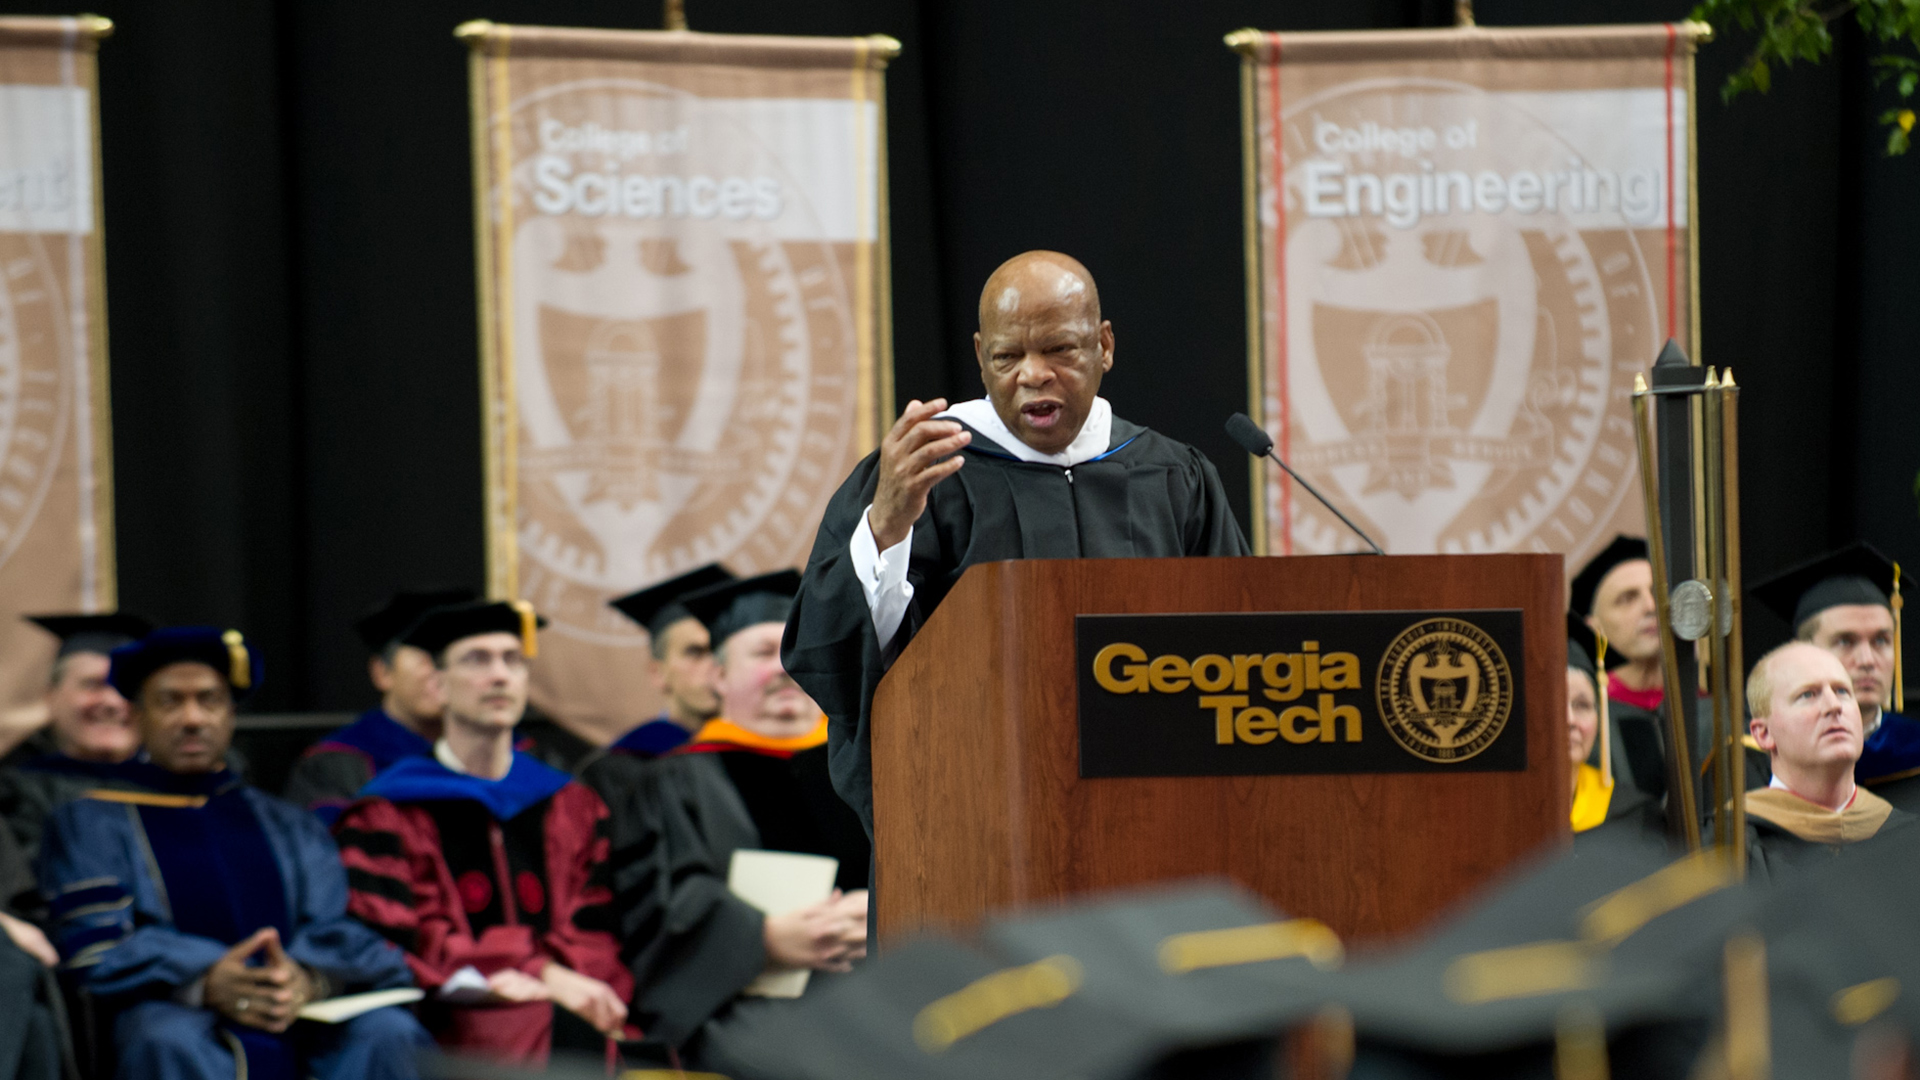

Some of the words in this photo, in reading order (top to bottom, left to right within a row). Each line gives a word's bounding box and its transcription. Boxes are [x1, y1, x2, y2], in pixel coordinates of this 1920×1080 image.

[540, 118, 652, 158] College
[654, 122, 691, 154] of
[1315, 120, 1437, 157] College
[1445, 117, 1478, 149] of
[532, 155, 782, 220] Sciences
[1304, 158, 1662, 230] Engineering
[1092, 640, 1362, 702] Georgia
[1199, 693, 1363, 745] Tech
